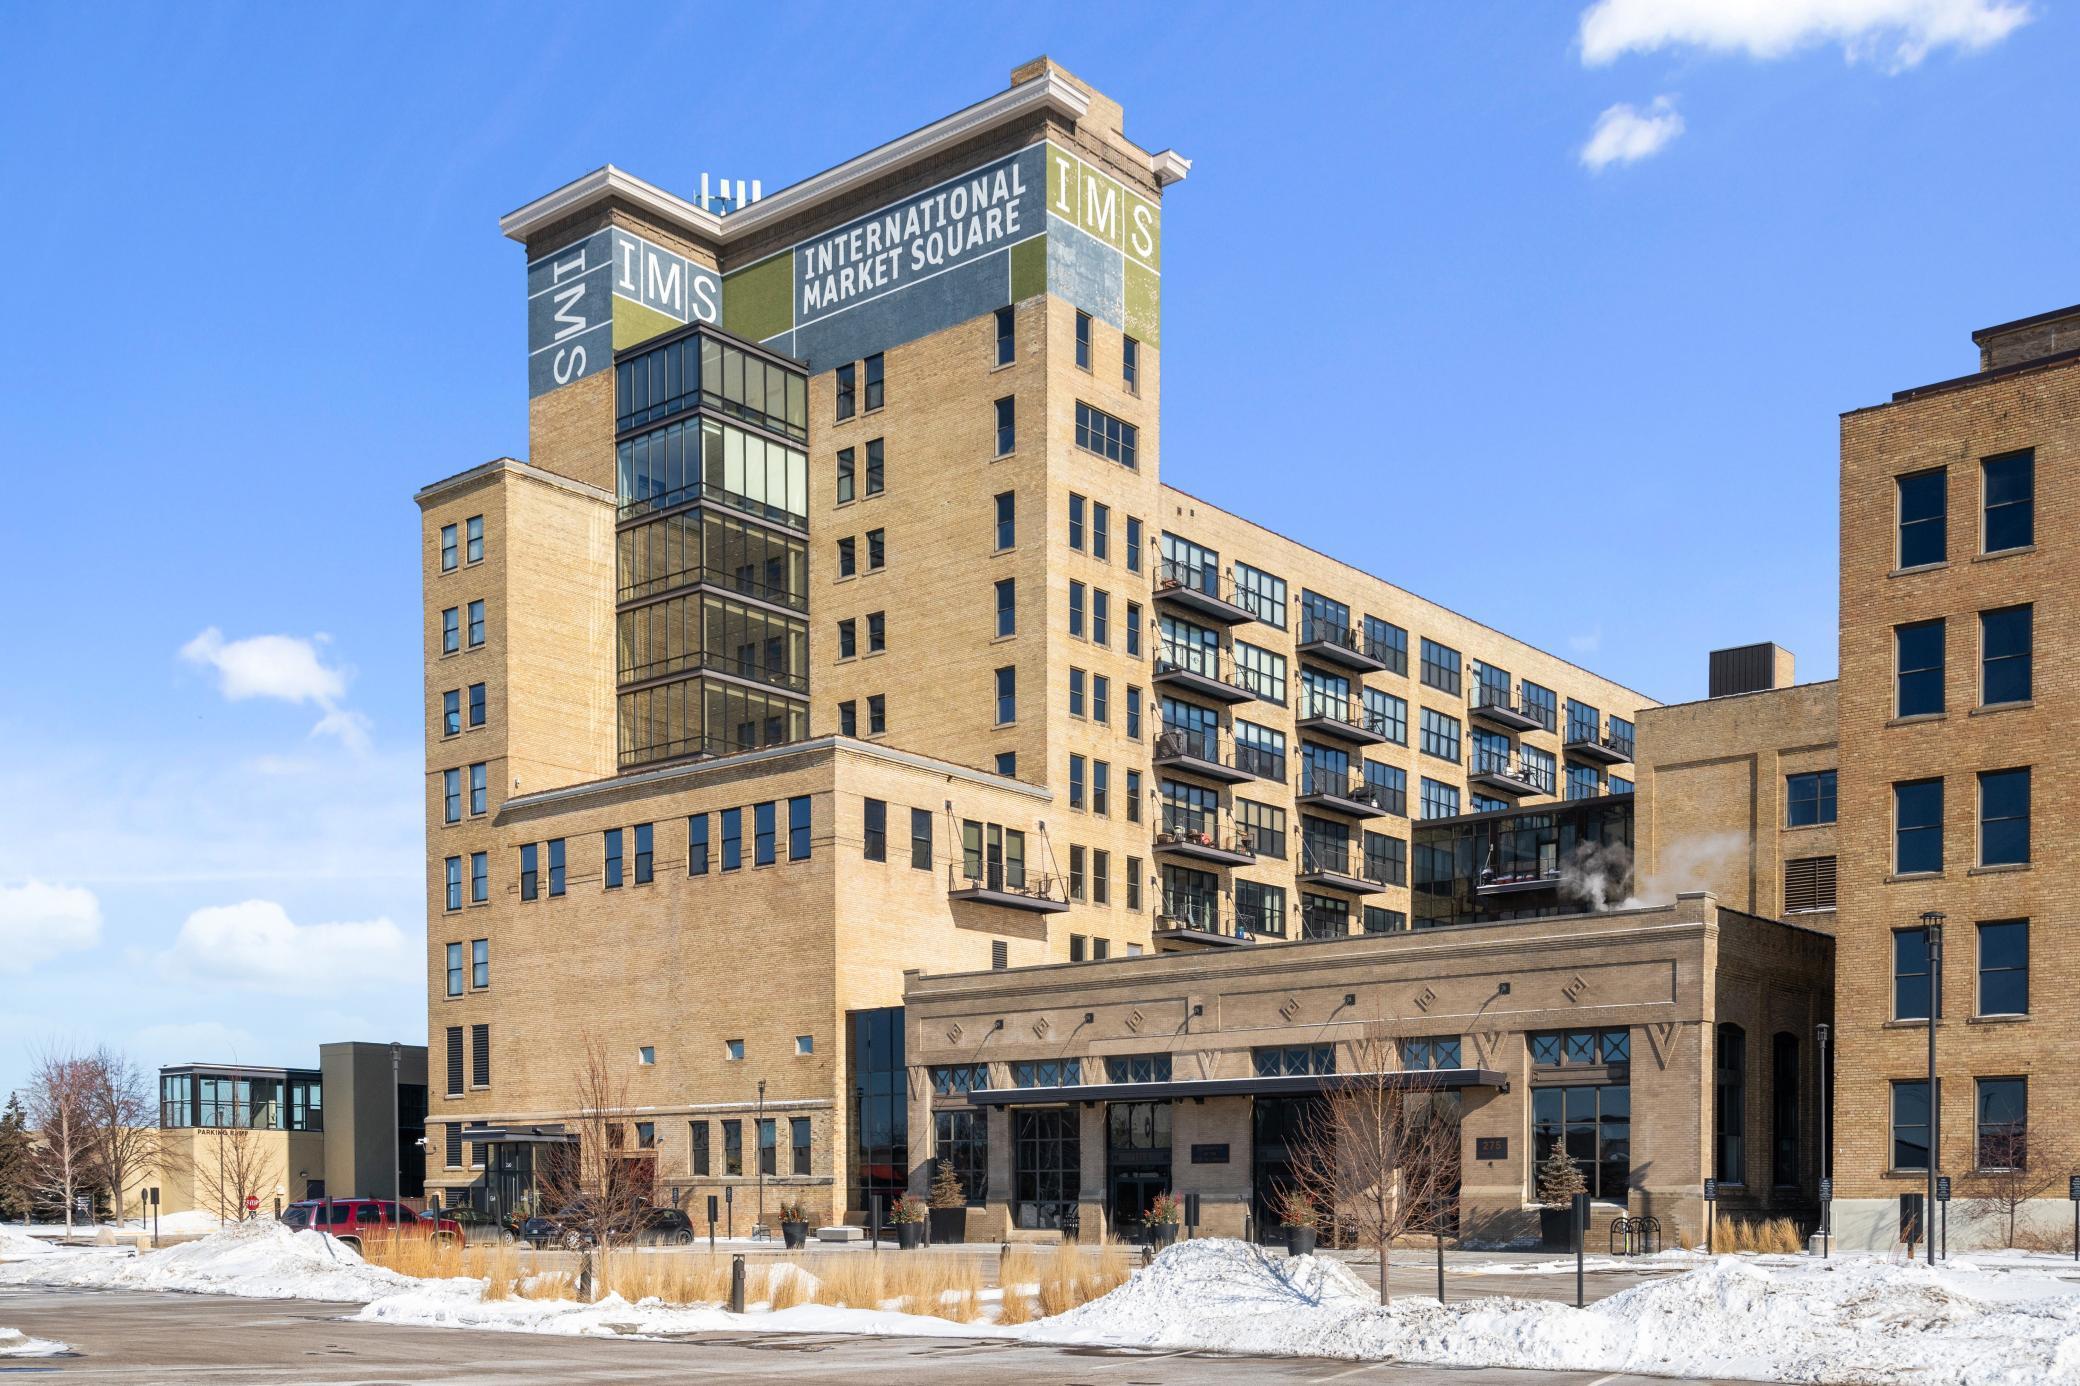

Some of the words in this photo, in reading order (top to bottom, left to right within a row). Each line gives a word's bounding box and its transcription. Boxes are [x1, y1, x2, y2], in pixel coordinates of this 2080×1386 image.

[803, 246, 903, 315] MARKET
[911, 199, 1021, 271] SQUARE
[805, 163, 1026, 280] INTERNATIONAL
[1056, 156, 1153, 257] IMS
[554, 249, 587, 385] IMS
[619, 239, 717, 324] IMS
[1482, 1140, 1502, 1150] 275
